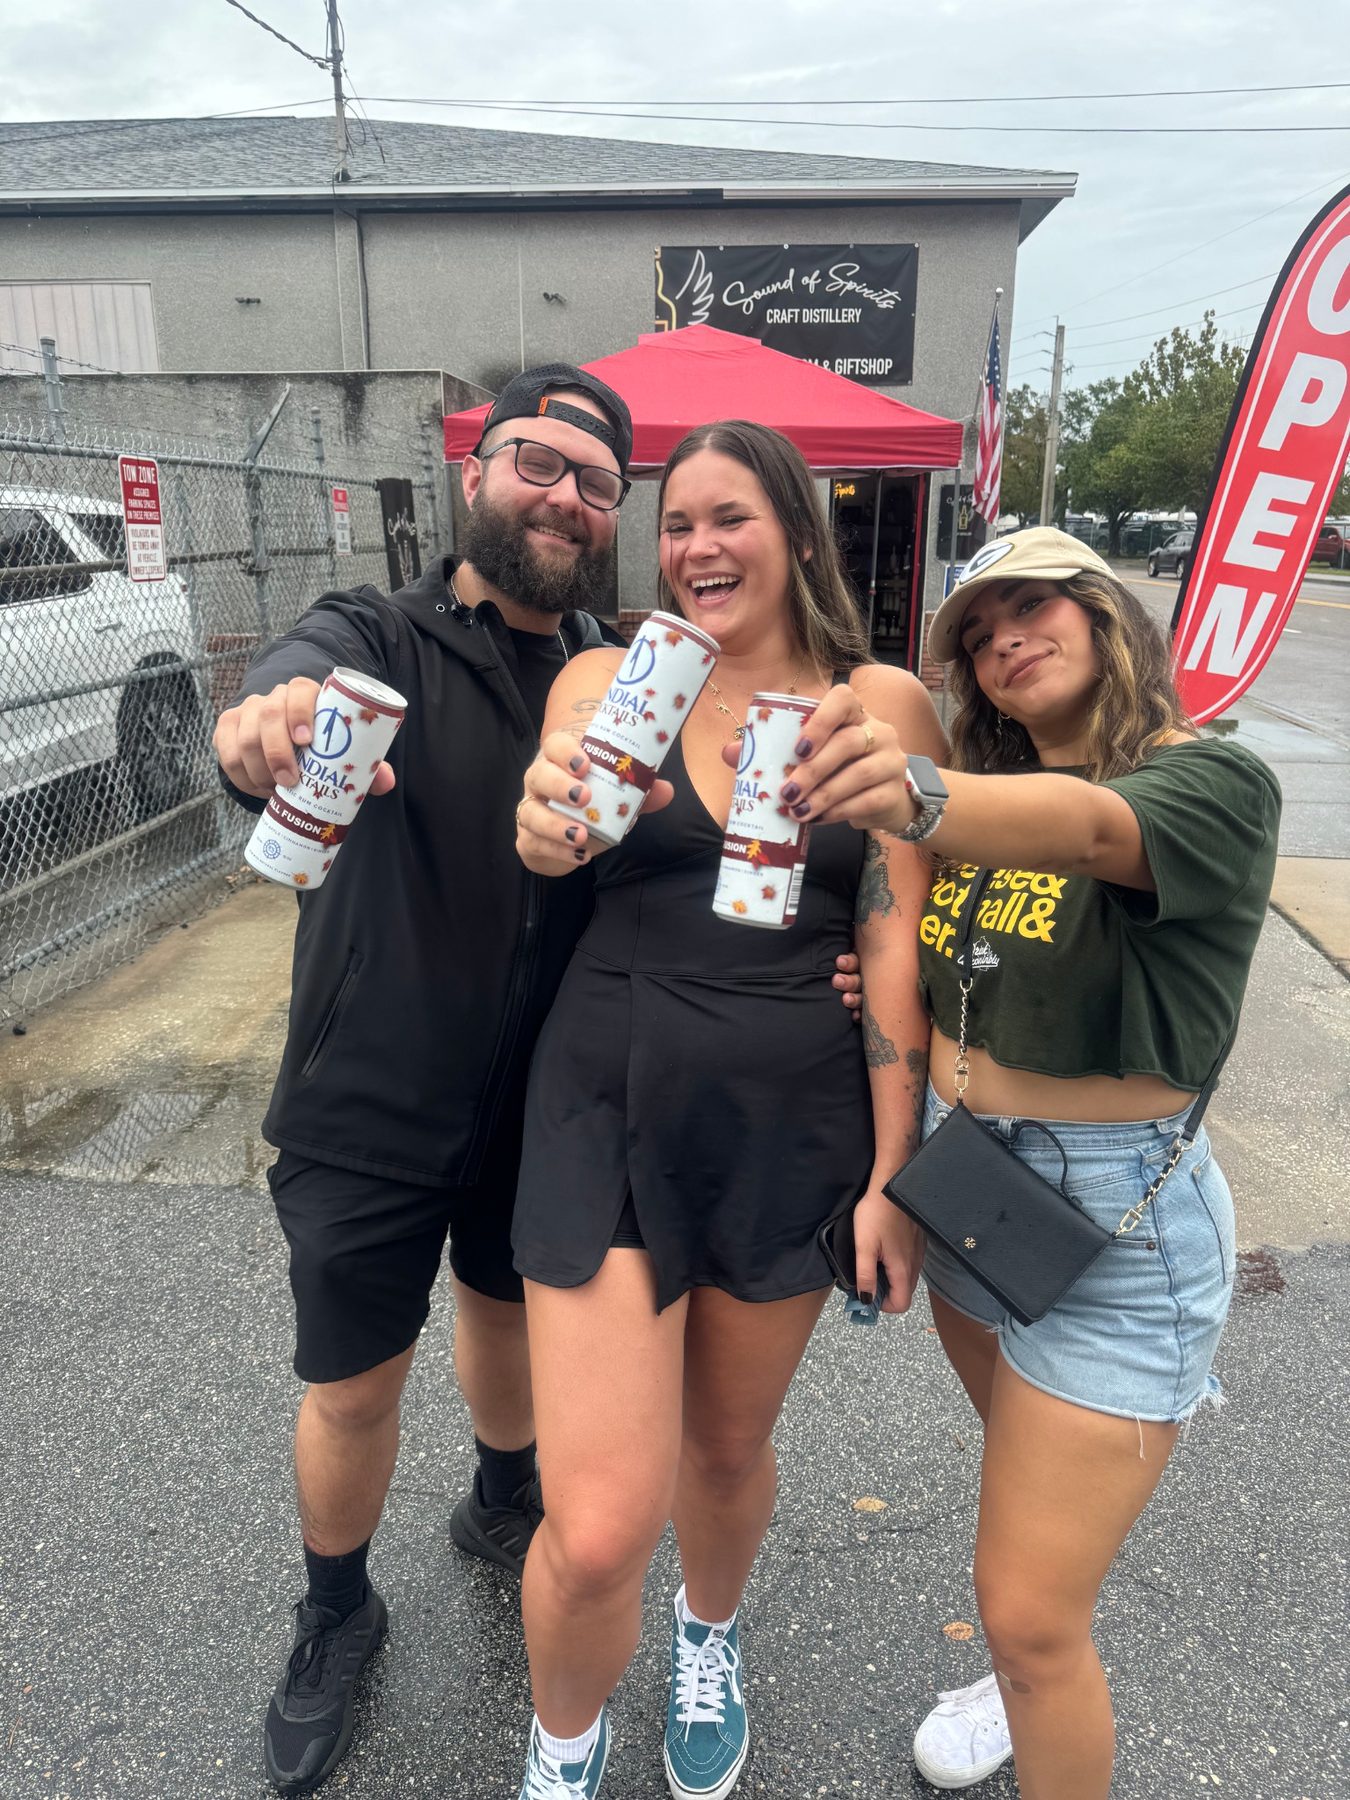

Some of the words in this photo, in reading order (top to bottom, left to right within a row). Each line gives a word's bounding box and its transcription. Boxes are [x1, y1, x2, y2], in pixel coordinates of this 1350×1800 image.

[722, 268, 796, 315] Sound
[801, 269, 822, 294] of
[825, 263, 902, 310] Spirits
[766, 309, 800, 324] CRAFT
[802, 308, 862, 323] DISTILLERY
[834, 358, 893, 375] GIFTSHOP
[1184, 234, 1350, 678] OPEN
[122, 464, 137, 482] TOW
[138, 466, 156, 485] ZONE
[583, 742, 618, 765] FUSION
[297, 751, 348, 790] NDIAL
[299, 770, 340, 800] KTAILS
[281, 809, 322, 835] FUSION
[313, 803, 343, 818] COCKTAIL
